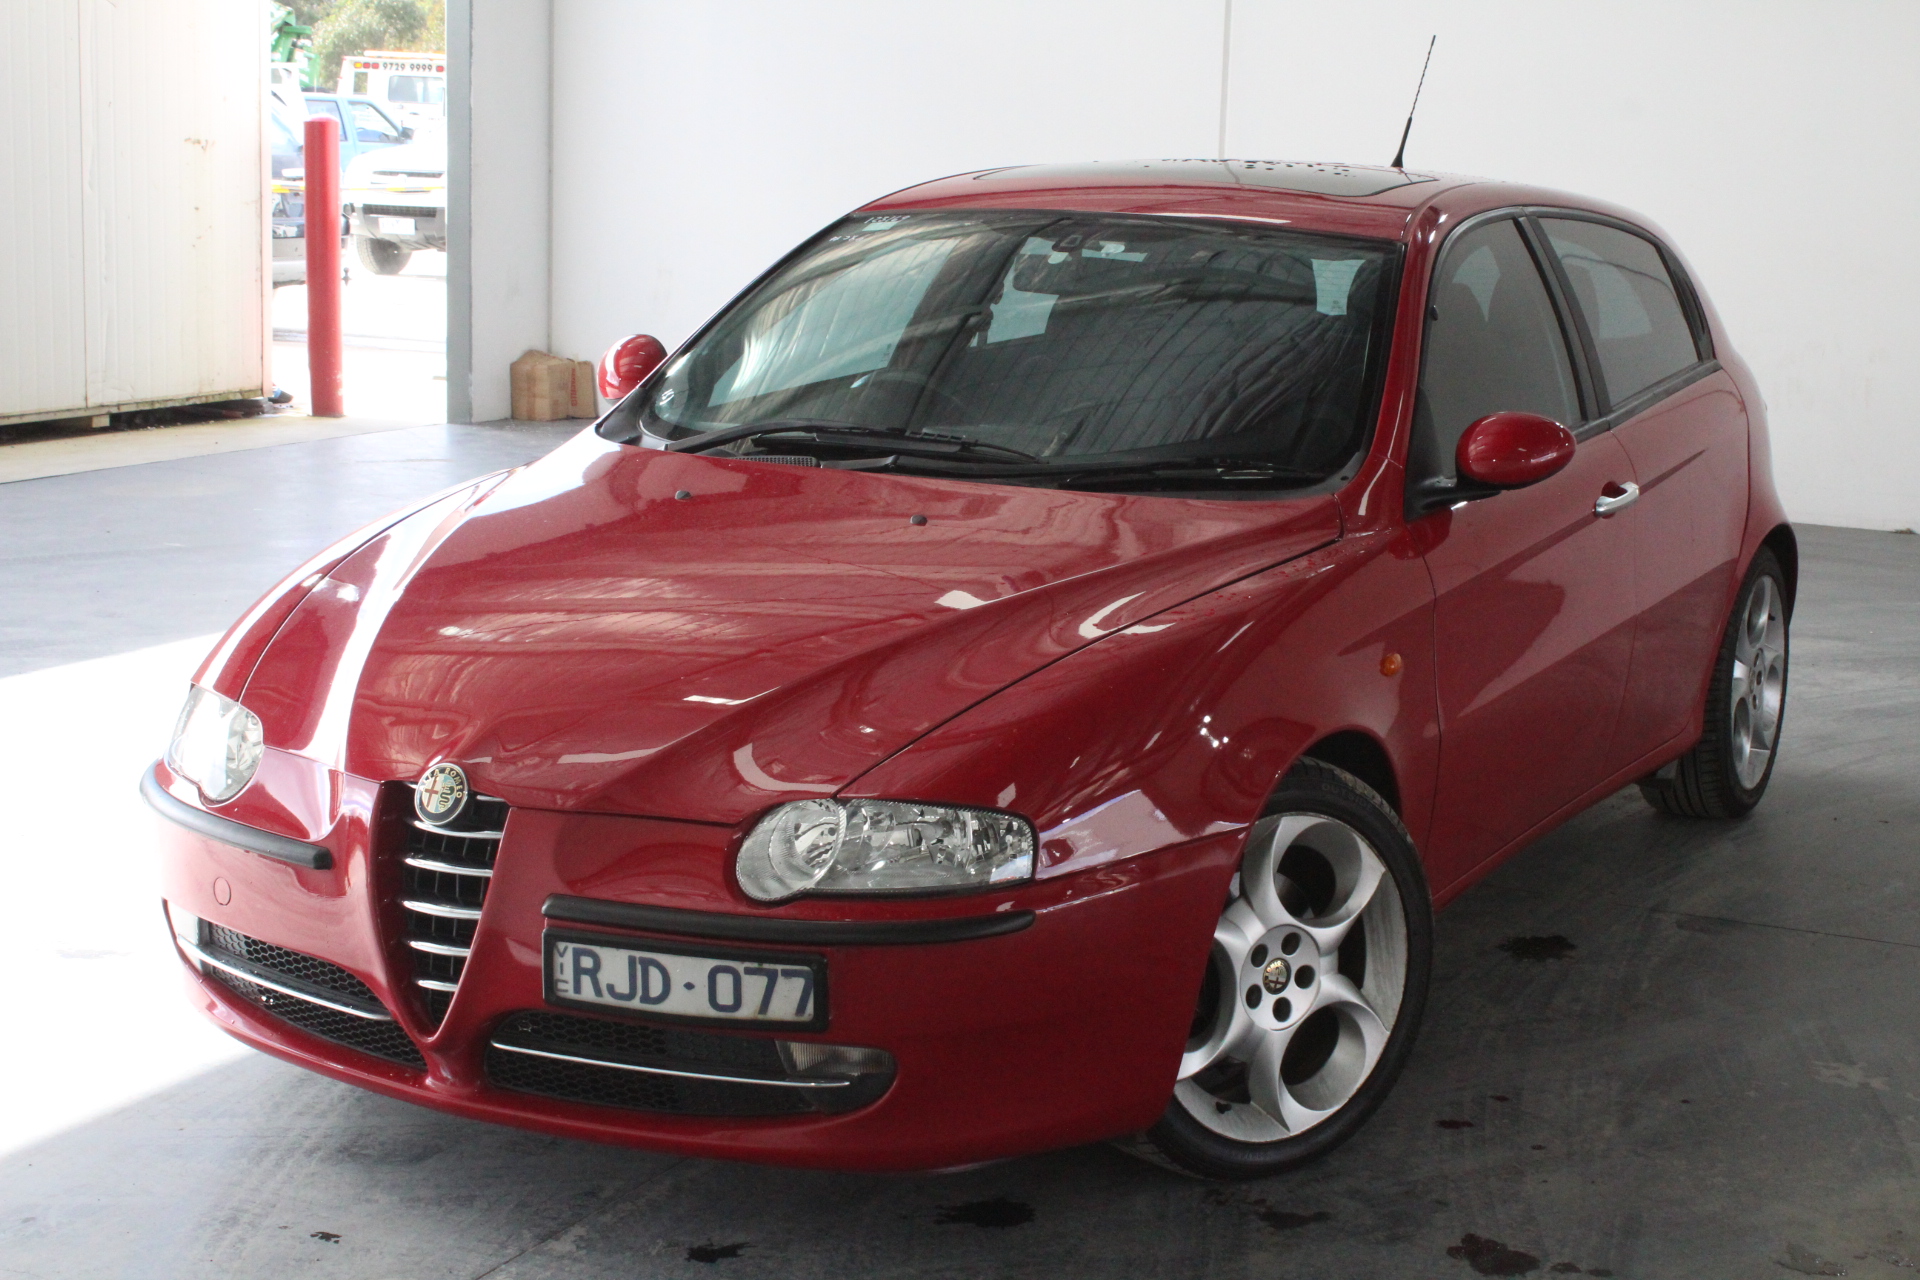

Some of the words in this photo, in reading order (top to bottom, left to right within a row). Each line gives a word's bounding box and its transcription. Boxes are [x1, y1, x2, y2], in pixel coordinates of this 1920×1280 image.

[383, 62, 405, 71] 9729
[409, 63, 433, 72] 9999
[444, 767, 463, 798] ROMEO
[554, 945, 569, 993] VIC
